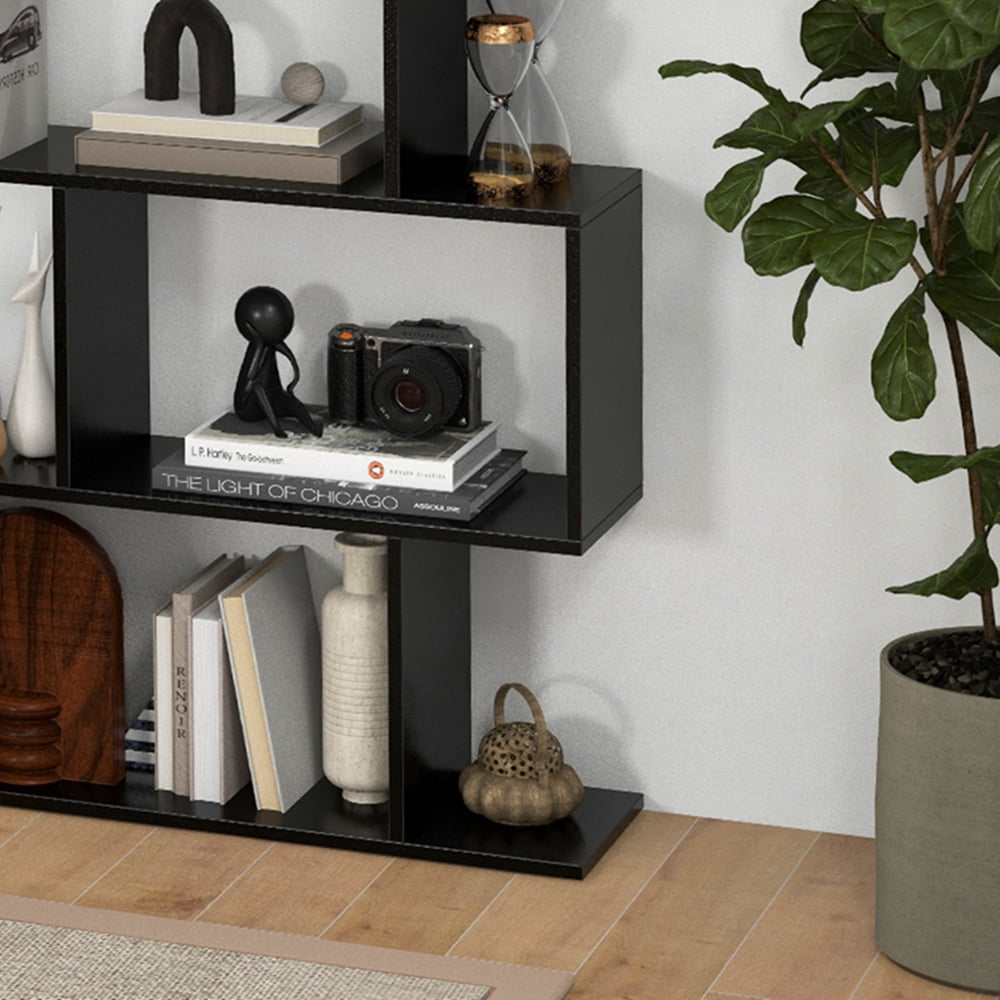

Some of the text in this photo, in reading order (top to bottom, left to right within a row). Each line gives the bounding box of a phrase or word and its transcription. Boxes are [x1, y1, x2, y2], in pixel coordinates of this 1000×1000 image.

[161, 473, 399, 511] THE LIGHT OF CHICAGO
[412, 502, 461, 514] ASSOULINE
[175, 666, 188, 738] RENOIR
